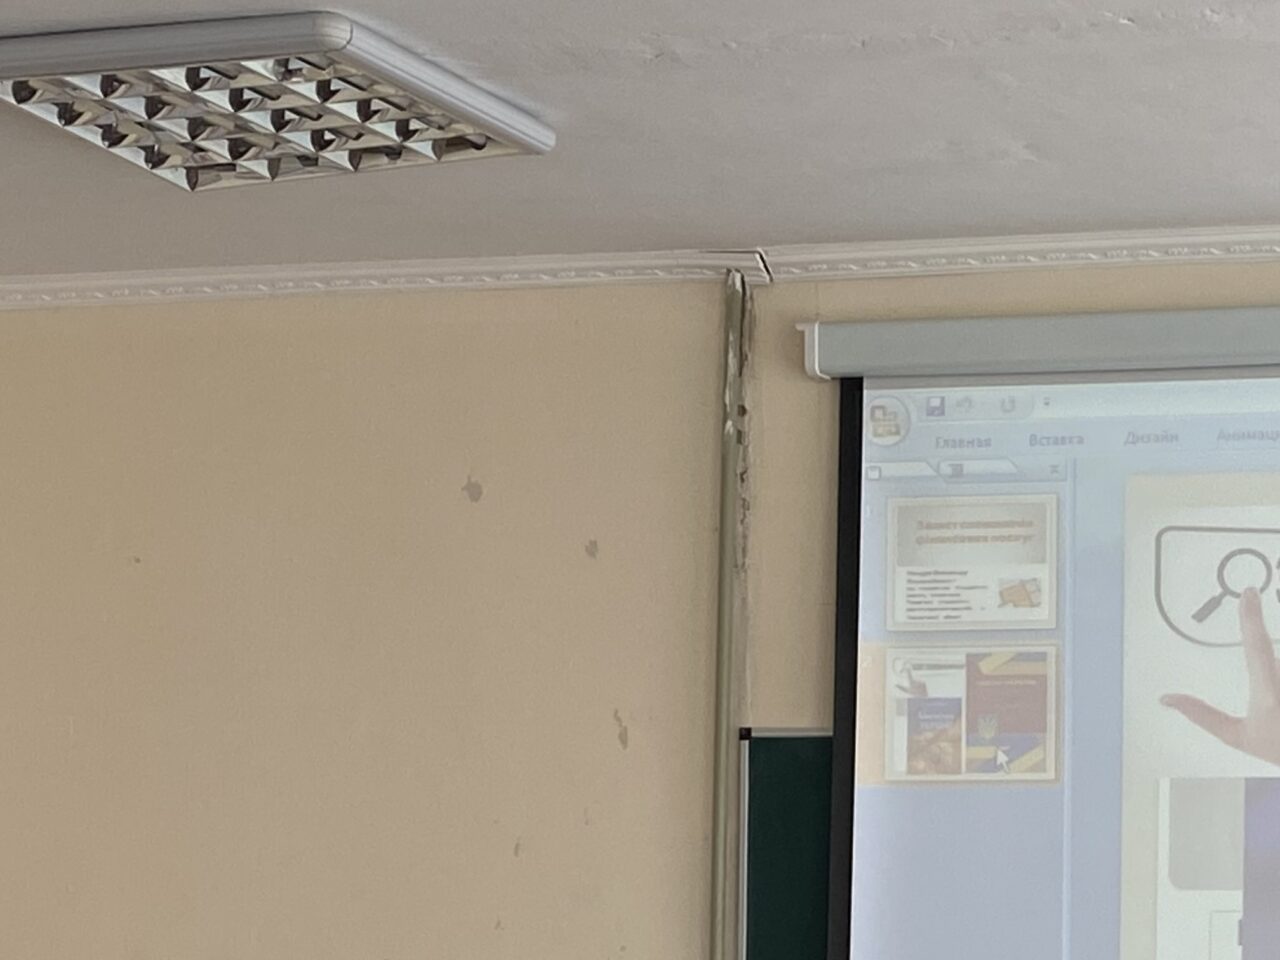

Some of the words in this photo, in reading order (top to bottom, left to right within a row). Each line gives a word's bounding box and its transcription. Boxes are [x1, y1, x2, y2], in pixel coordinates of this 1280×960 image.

[935, 434, 992, 449] Главная
[1028, 432, 1085, 448] Вставка
[1123, 430, 1180, 447] Дизайн
